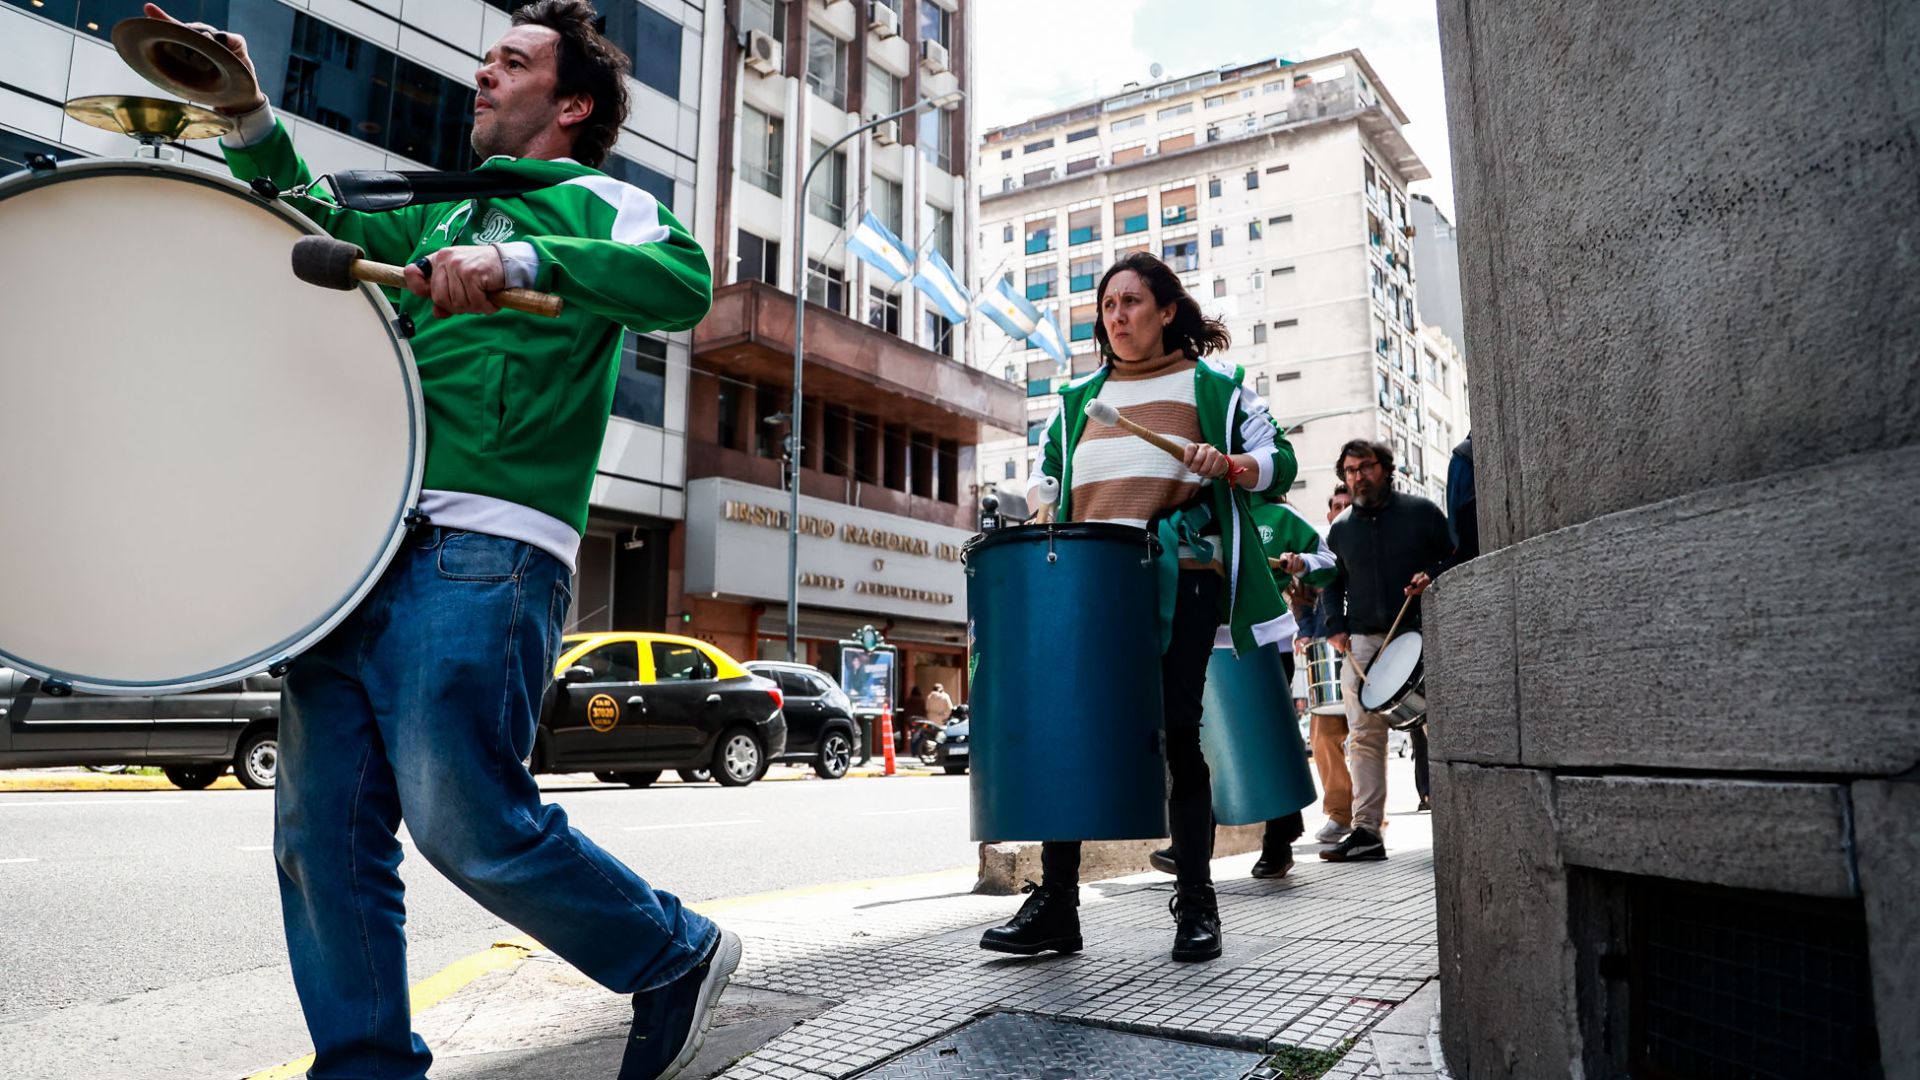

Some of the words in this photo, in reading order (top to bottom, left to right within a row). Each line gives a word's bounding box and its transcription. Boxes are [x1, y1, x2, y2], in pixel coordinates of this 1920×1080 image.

[726, 499, 835, 538] INSTITUTO
[842, 524, 930, 556] NACIONAL
[937, 543, 960, 562] DE
